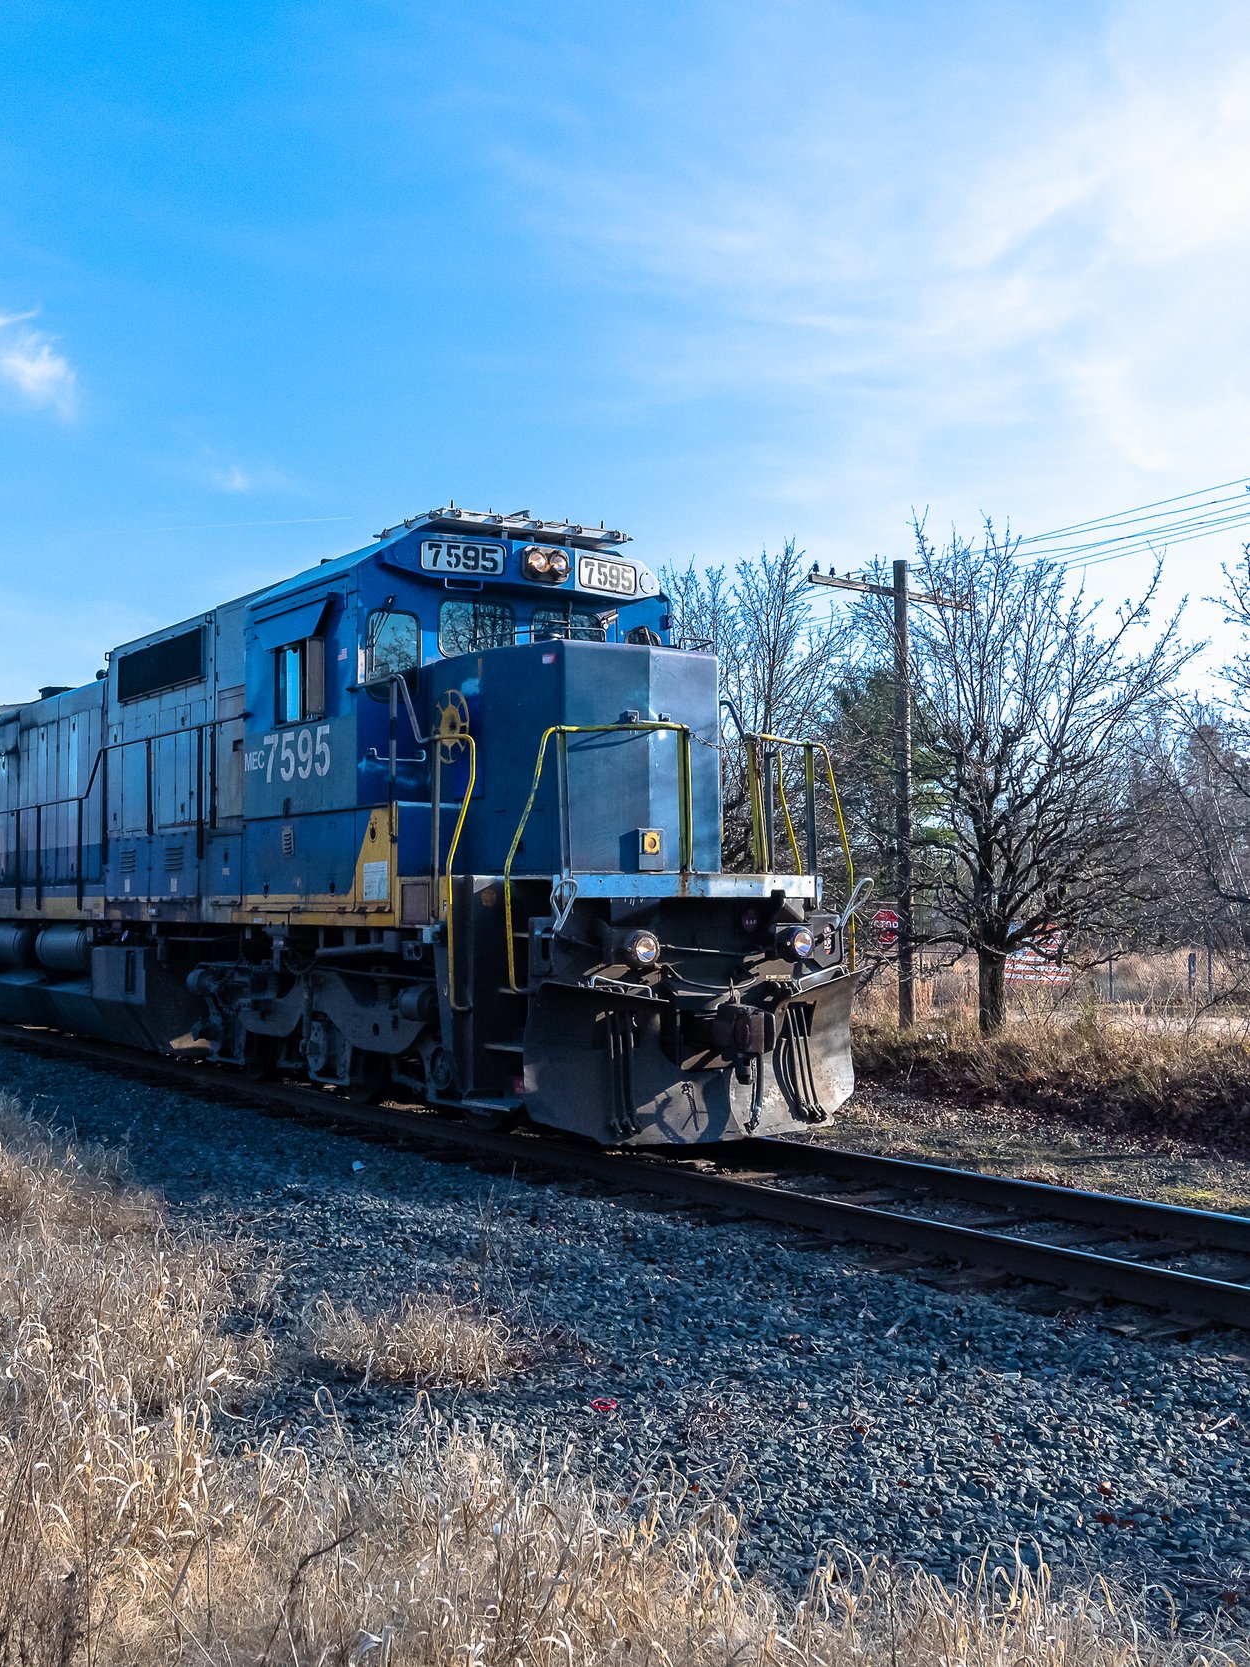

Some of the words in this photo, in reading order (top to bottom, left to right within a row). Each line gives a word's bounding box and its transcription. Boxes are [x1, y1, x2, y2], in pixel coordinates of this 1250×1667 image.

[427, 543, 498, 573] 7595
[584, 561, 633, 591] 7595
[244, 750, 265, 772] MEC
[263, 724, 331, 783] 7595
